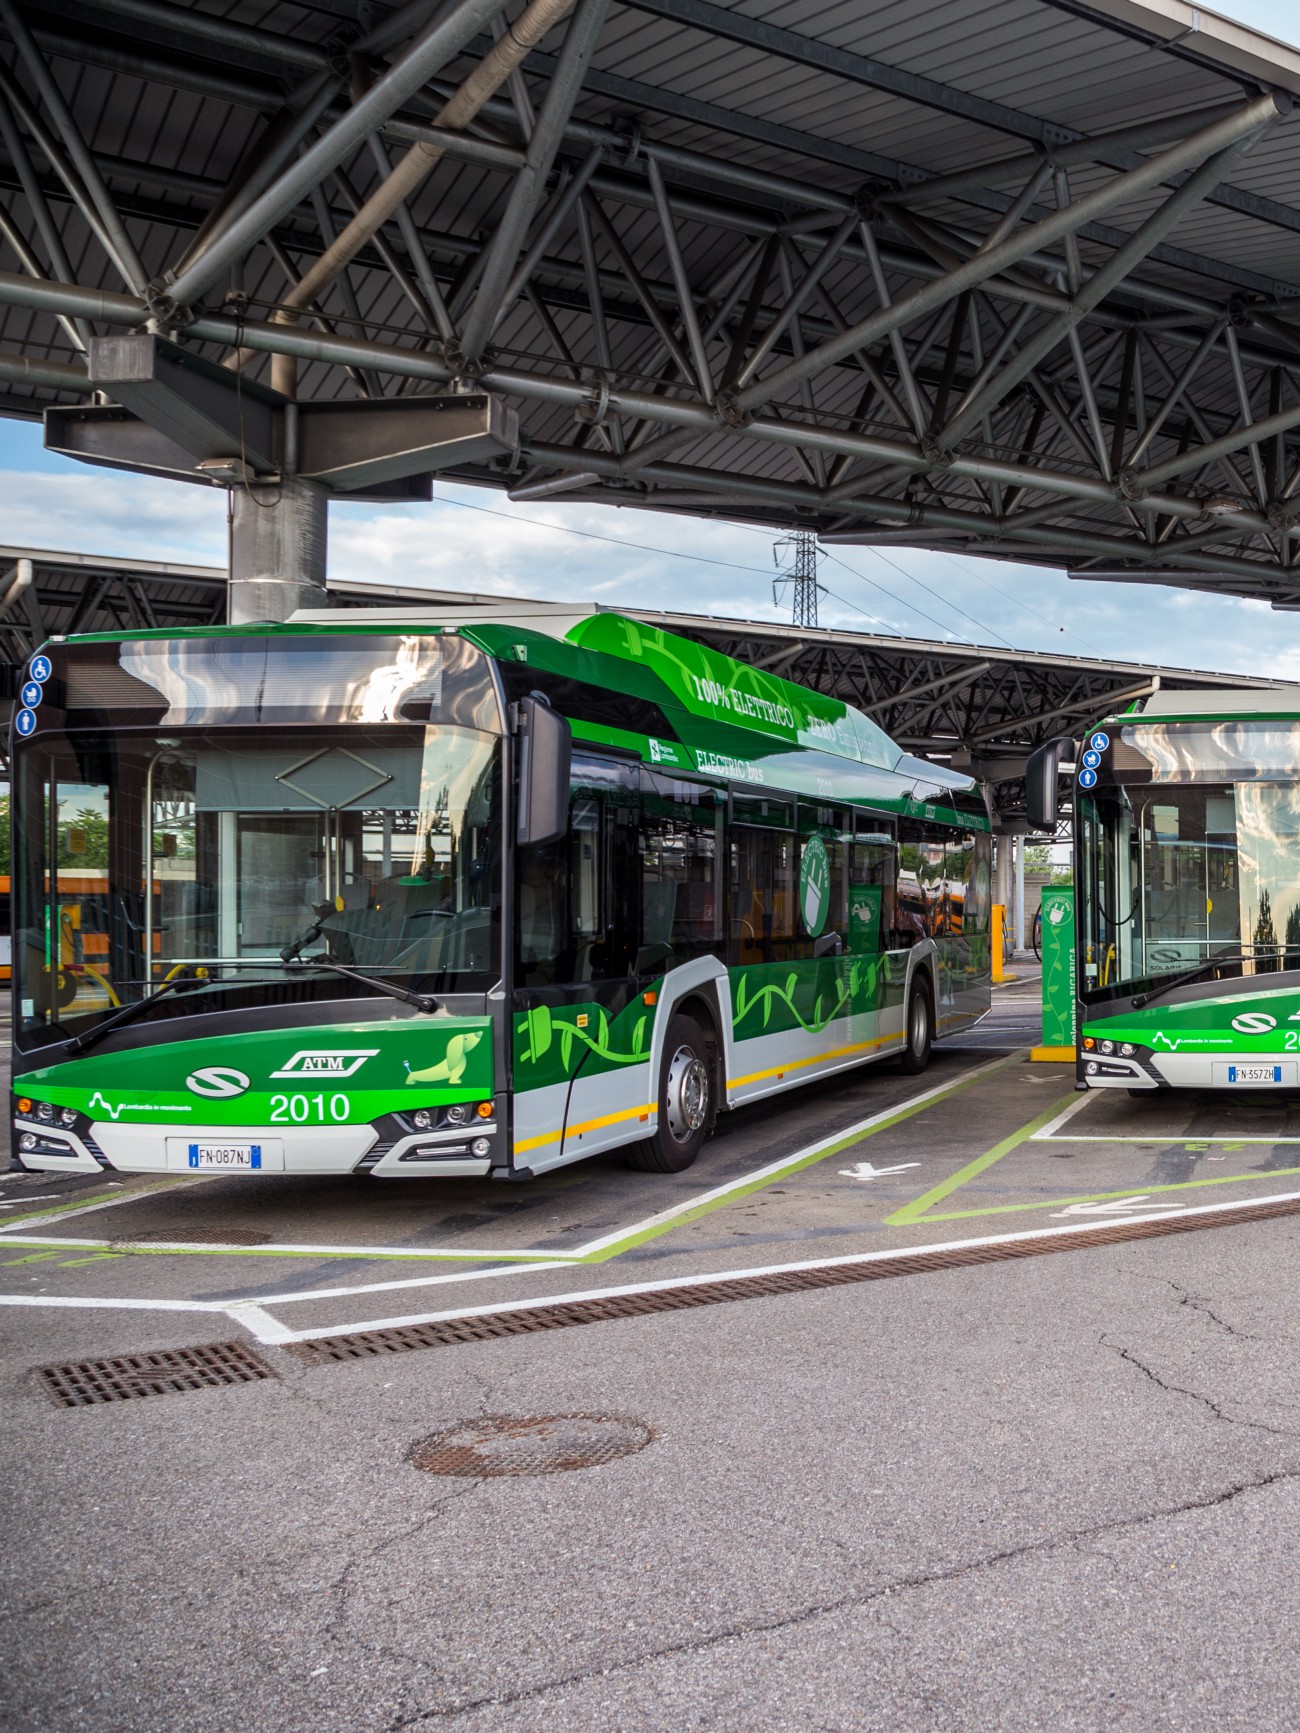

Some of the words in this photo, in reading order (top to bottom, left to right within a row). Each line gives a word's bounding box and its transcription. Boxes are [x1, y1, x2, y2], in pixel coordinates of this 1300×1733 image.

[693, 676, 730, 710] 100%
[730, 688, 795, 729] ELETTRICO
[808, 714, 837, 742] ZERO
[695, 749, 746, 776] ELECTRIC
[746, 760, 764, 783] bus
[300, 1057, 345, 1071] ATM
[269, 1093, 350, 1122] 2010
